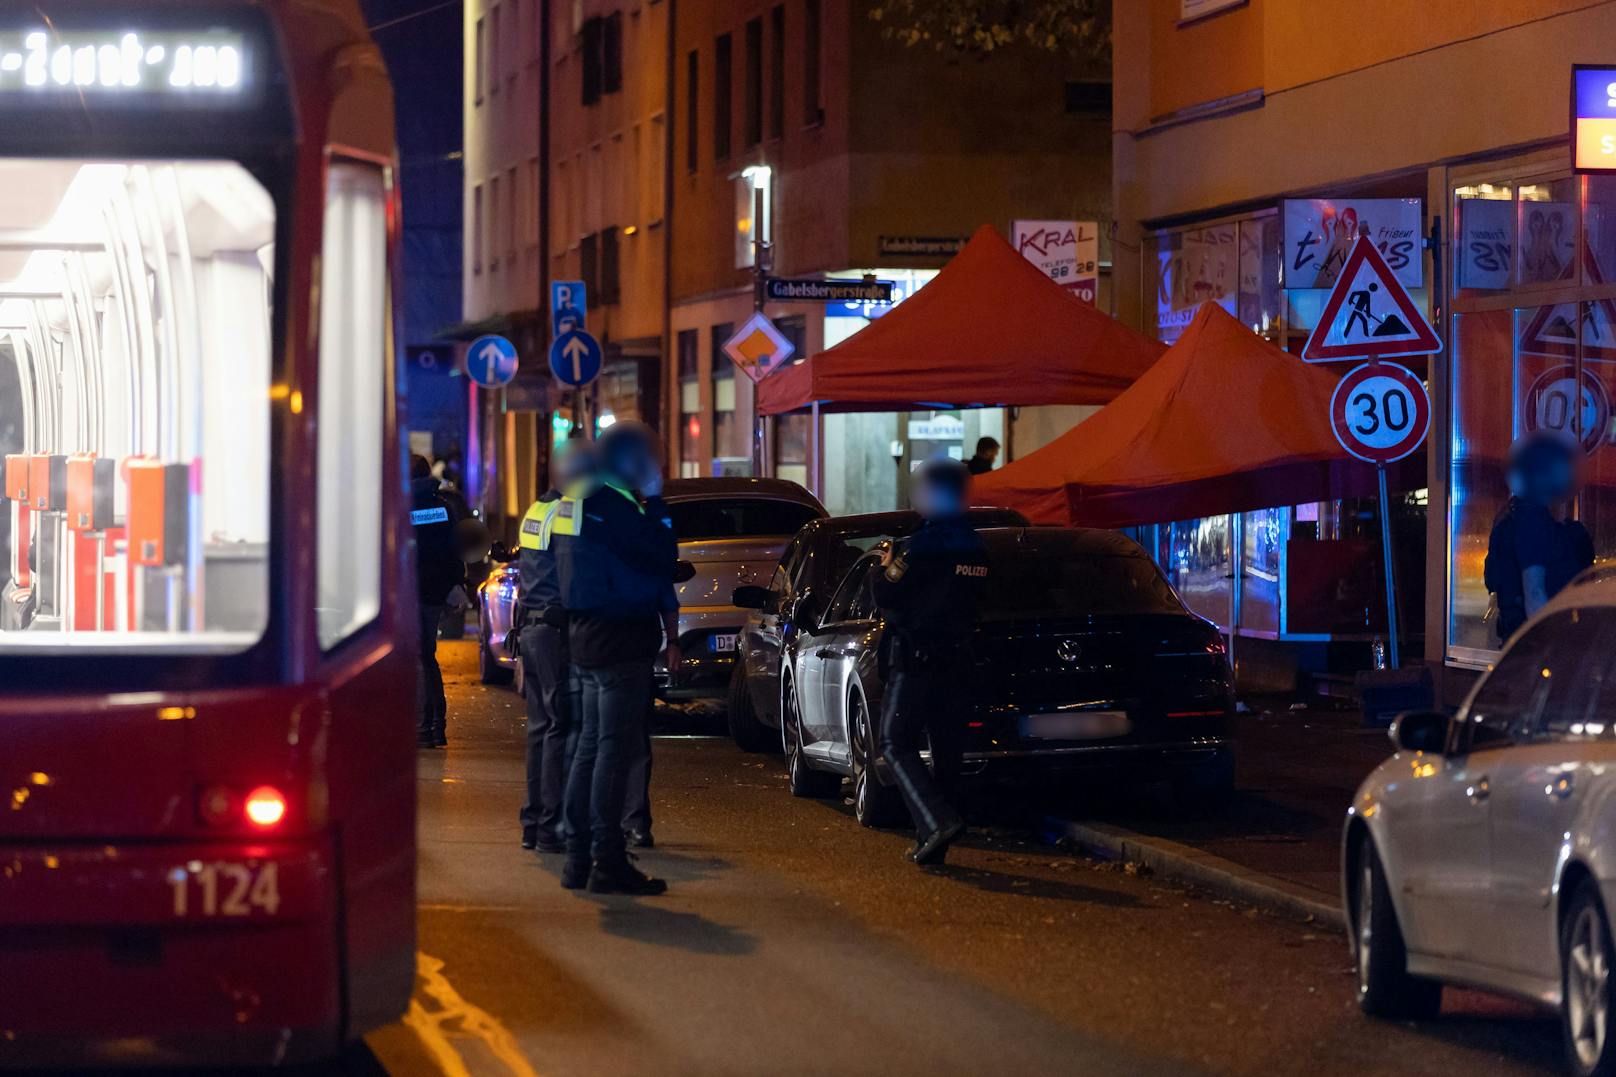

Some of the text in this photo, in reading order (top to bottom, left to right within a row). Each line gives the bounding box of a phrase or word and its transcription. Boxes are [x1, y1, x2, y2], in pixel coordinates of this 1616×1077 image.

[1019, 226, 1094, 256] KRAL
[1378, 226, 1414, 239] Friseur
[773, 281, 886, 300] Gabelsbergerstraße
[1352, 388, 1409, 436] 30
[955, 564, 989, 577] POLIZEI
[167, 860, 281, 917] 1124
